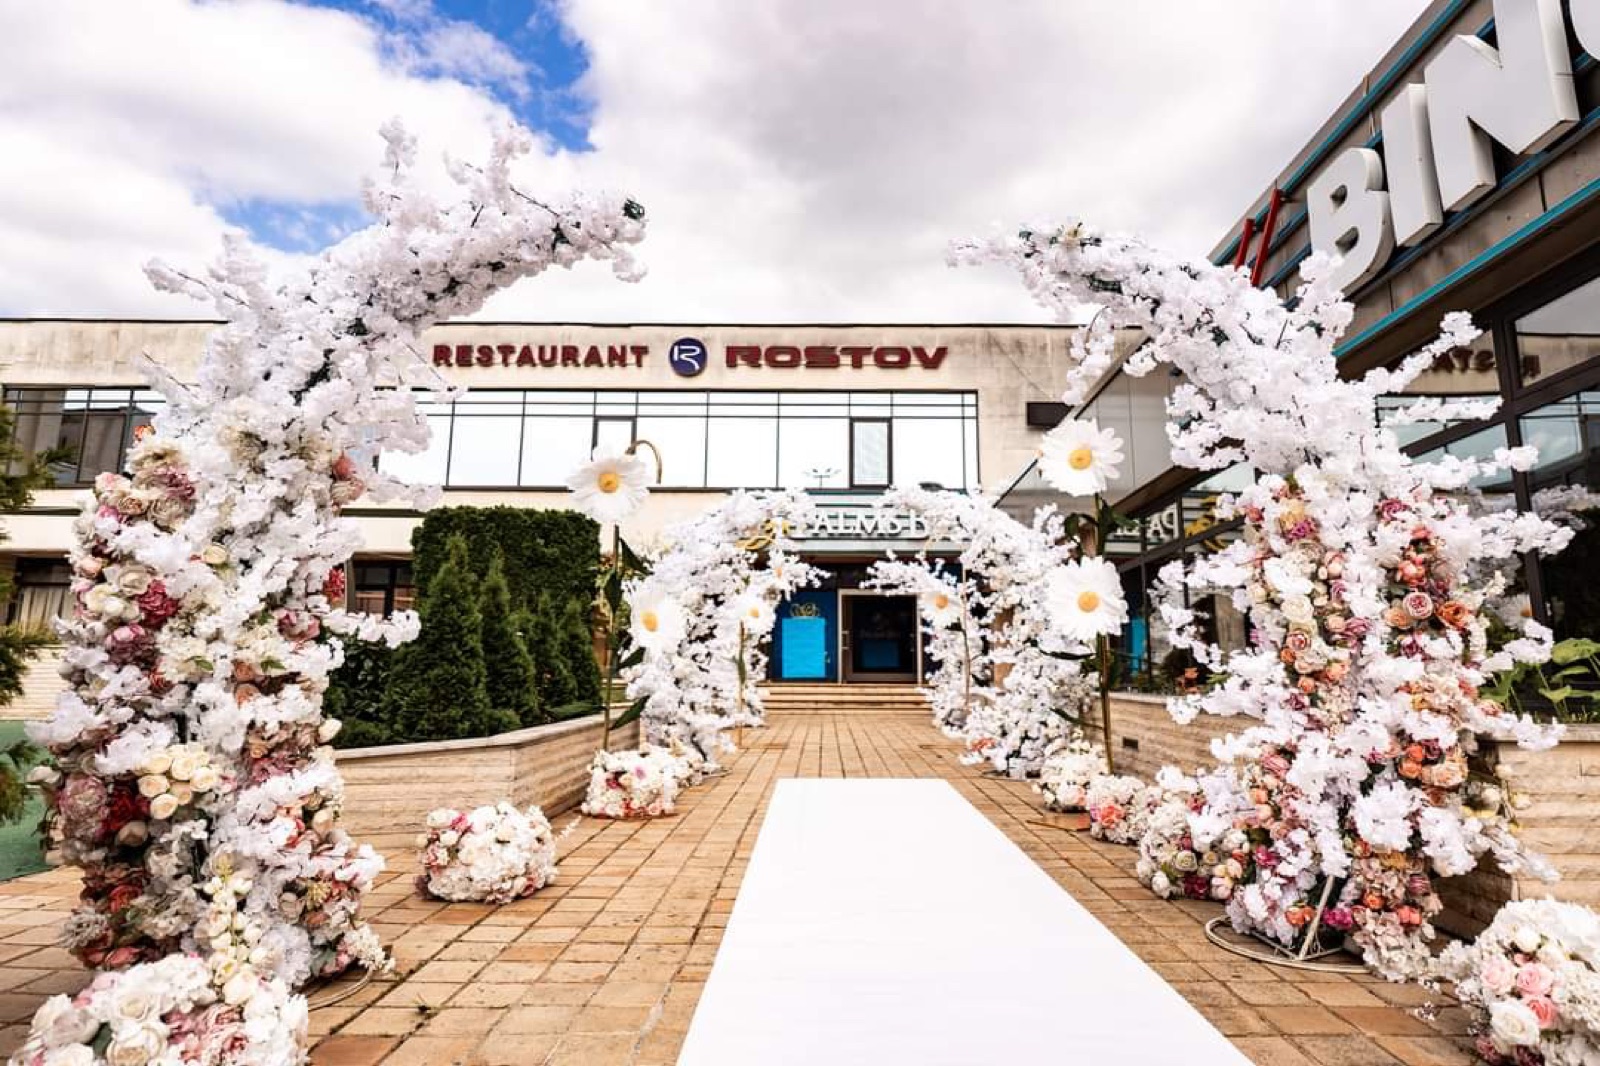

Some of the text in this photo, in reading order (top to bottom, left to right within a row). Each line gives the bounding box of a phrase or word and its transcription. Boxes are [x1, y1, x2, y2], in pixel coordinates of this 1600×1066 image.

[1306, 0, 1600, 298] BIN
[433, 344, 650, 368] RESTAURANT
[725, 345, 949, 369] ROSTOV
[810, 508, 902, 535] ALMS
